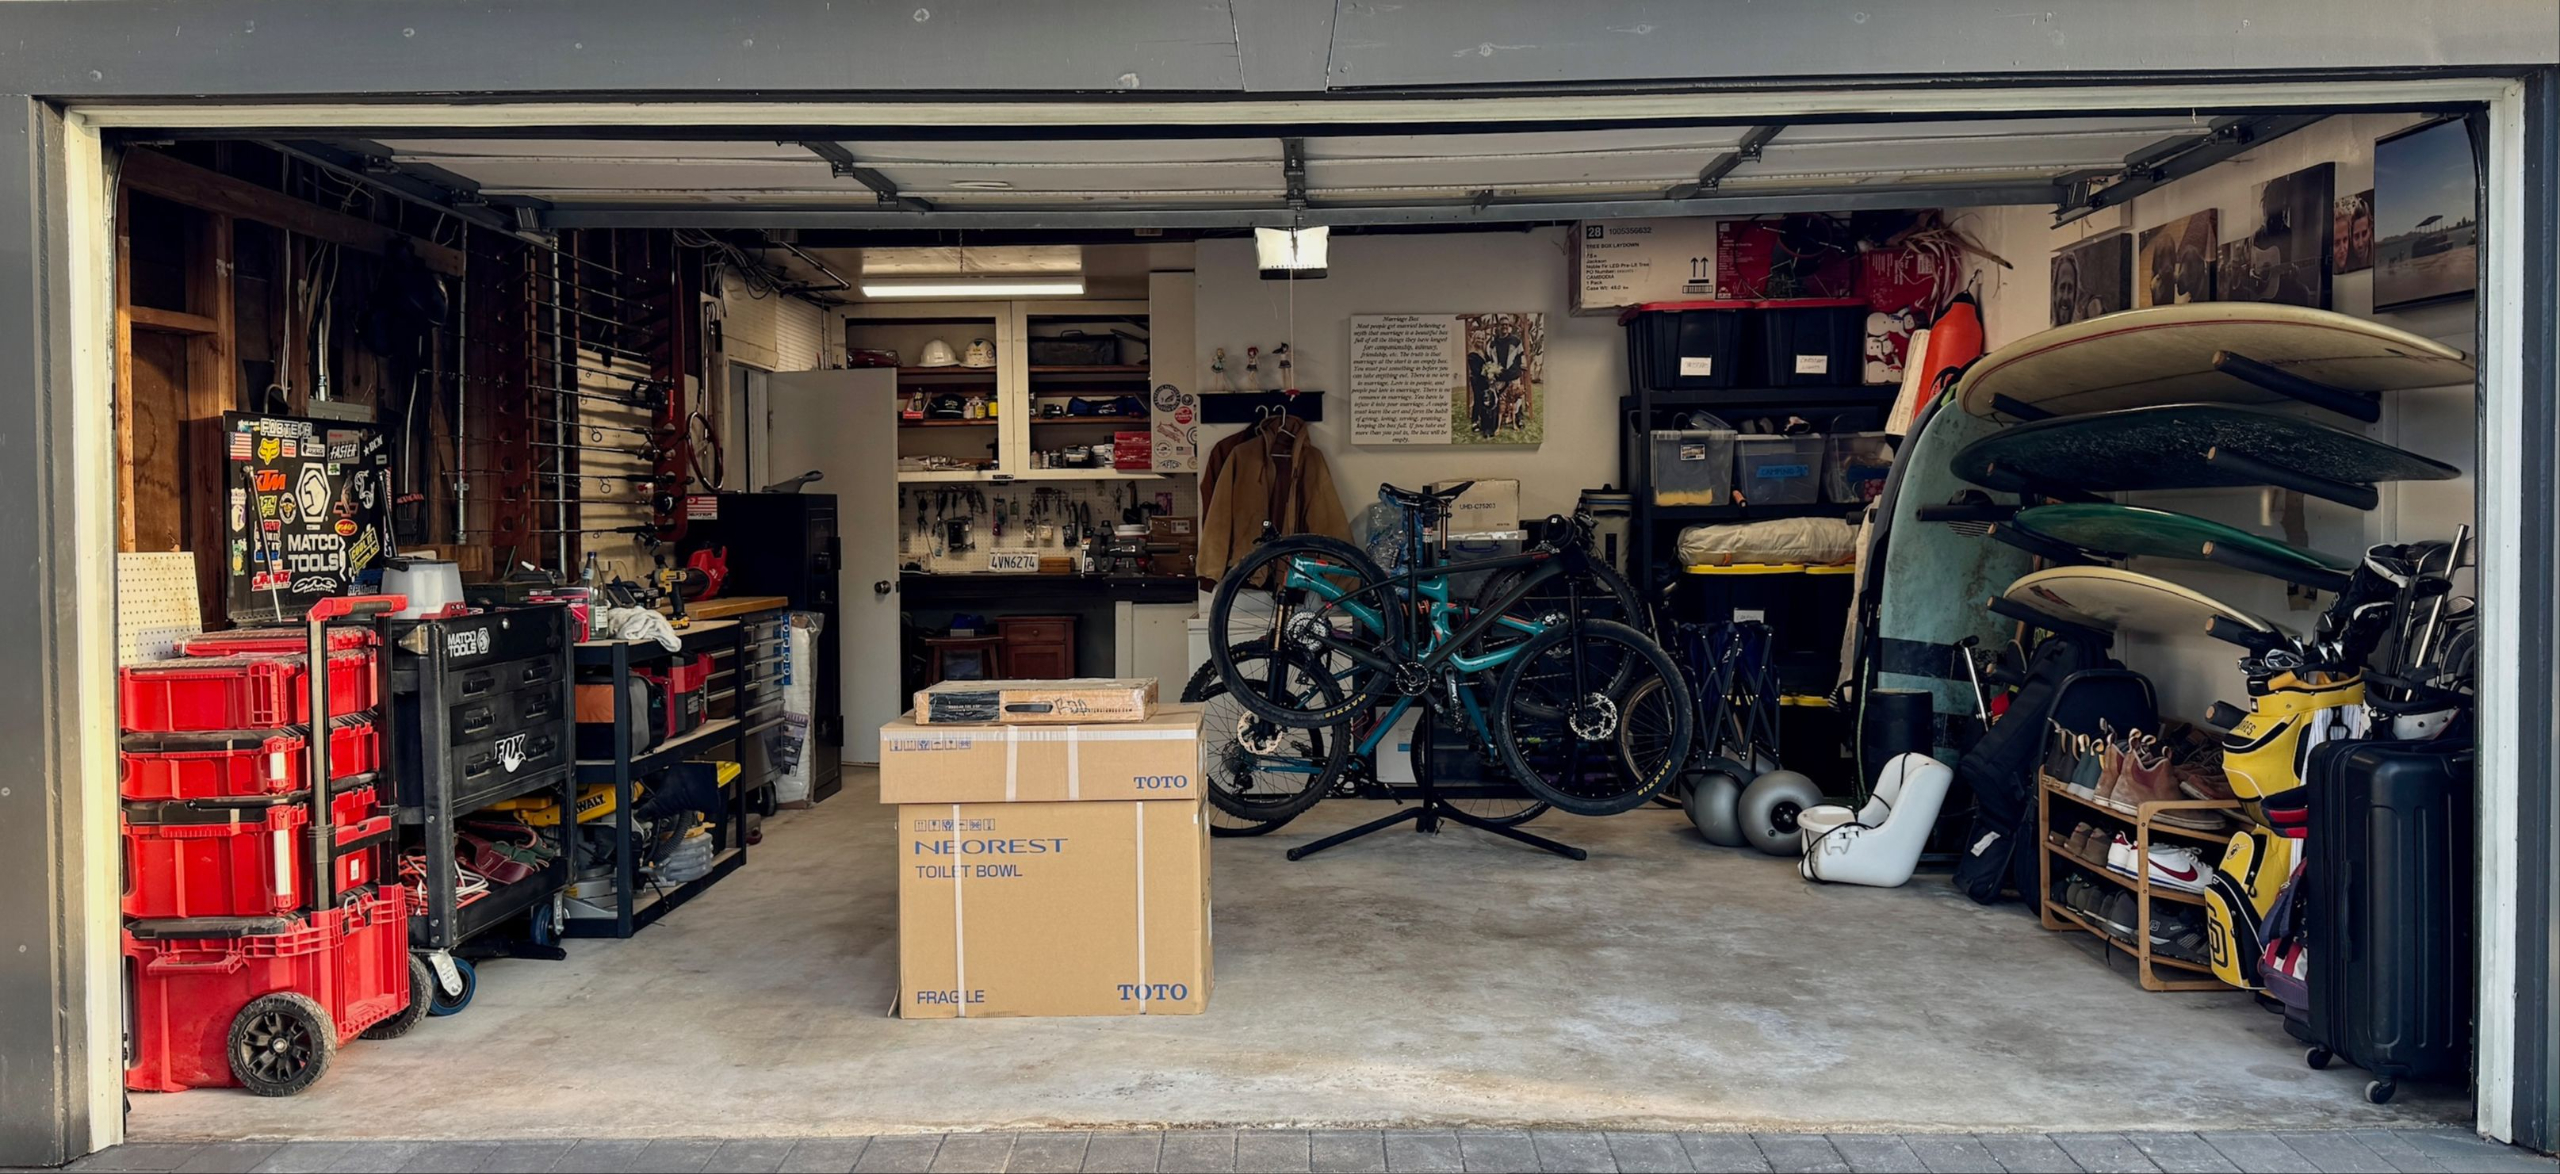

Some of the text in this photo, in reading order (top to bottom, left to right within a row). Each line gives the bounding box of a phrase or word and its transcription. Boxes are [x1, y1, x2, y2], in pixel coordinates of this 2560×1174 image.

[1588, 227, 1602, 237] 28
[256, 470, 286, 491] KTM
[288, 534, 338, 552] MATCO
[288, 553, 338, 572] TOOLS
[991, 556, 1035, 569] 4VN6274
[448, 631, 476, 646] MATCO
[448, 644, 477, 657] TOOLS
[1325, 693, 1366, 718] MAXXIS
[495, 734, 525, 764] FOX
[1134, 775, 1187, 789] TOTO
[1637, 759, 1671, 796] MAXXIS
[577, 793, 606, 813] WALT
[915, 838, 1068, 854] NEOREST
[976, 864, 1023, 877] BOWL
[917, 984, 1188, 1004] FRAGLE TOTO
